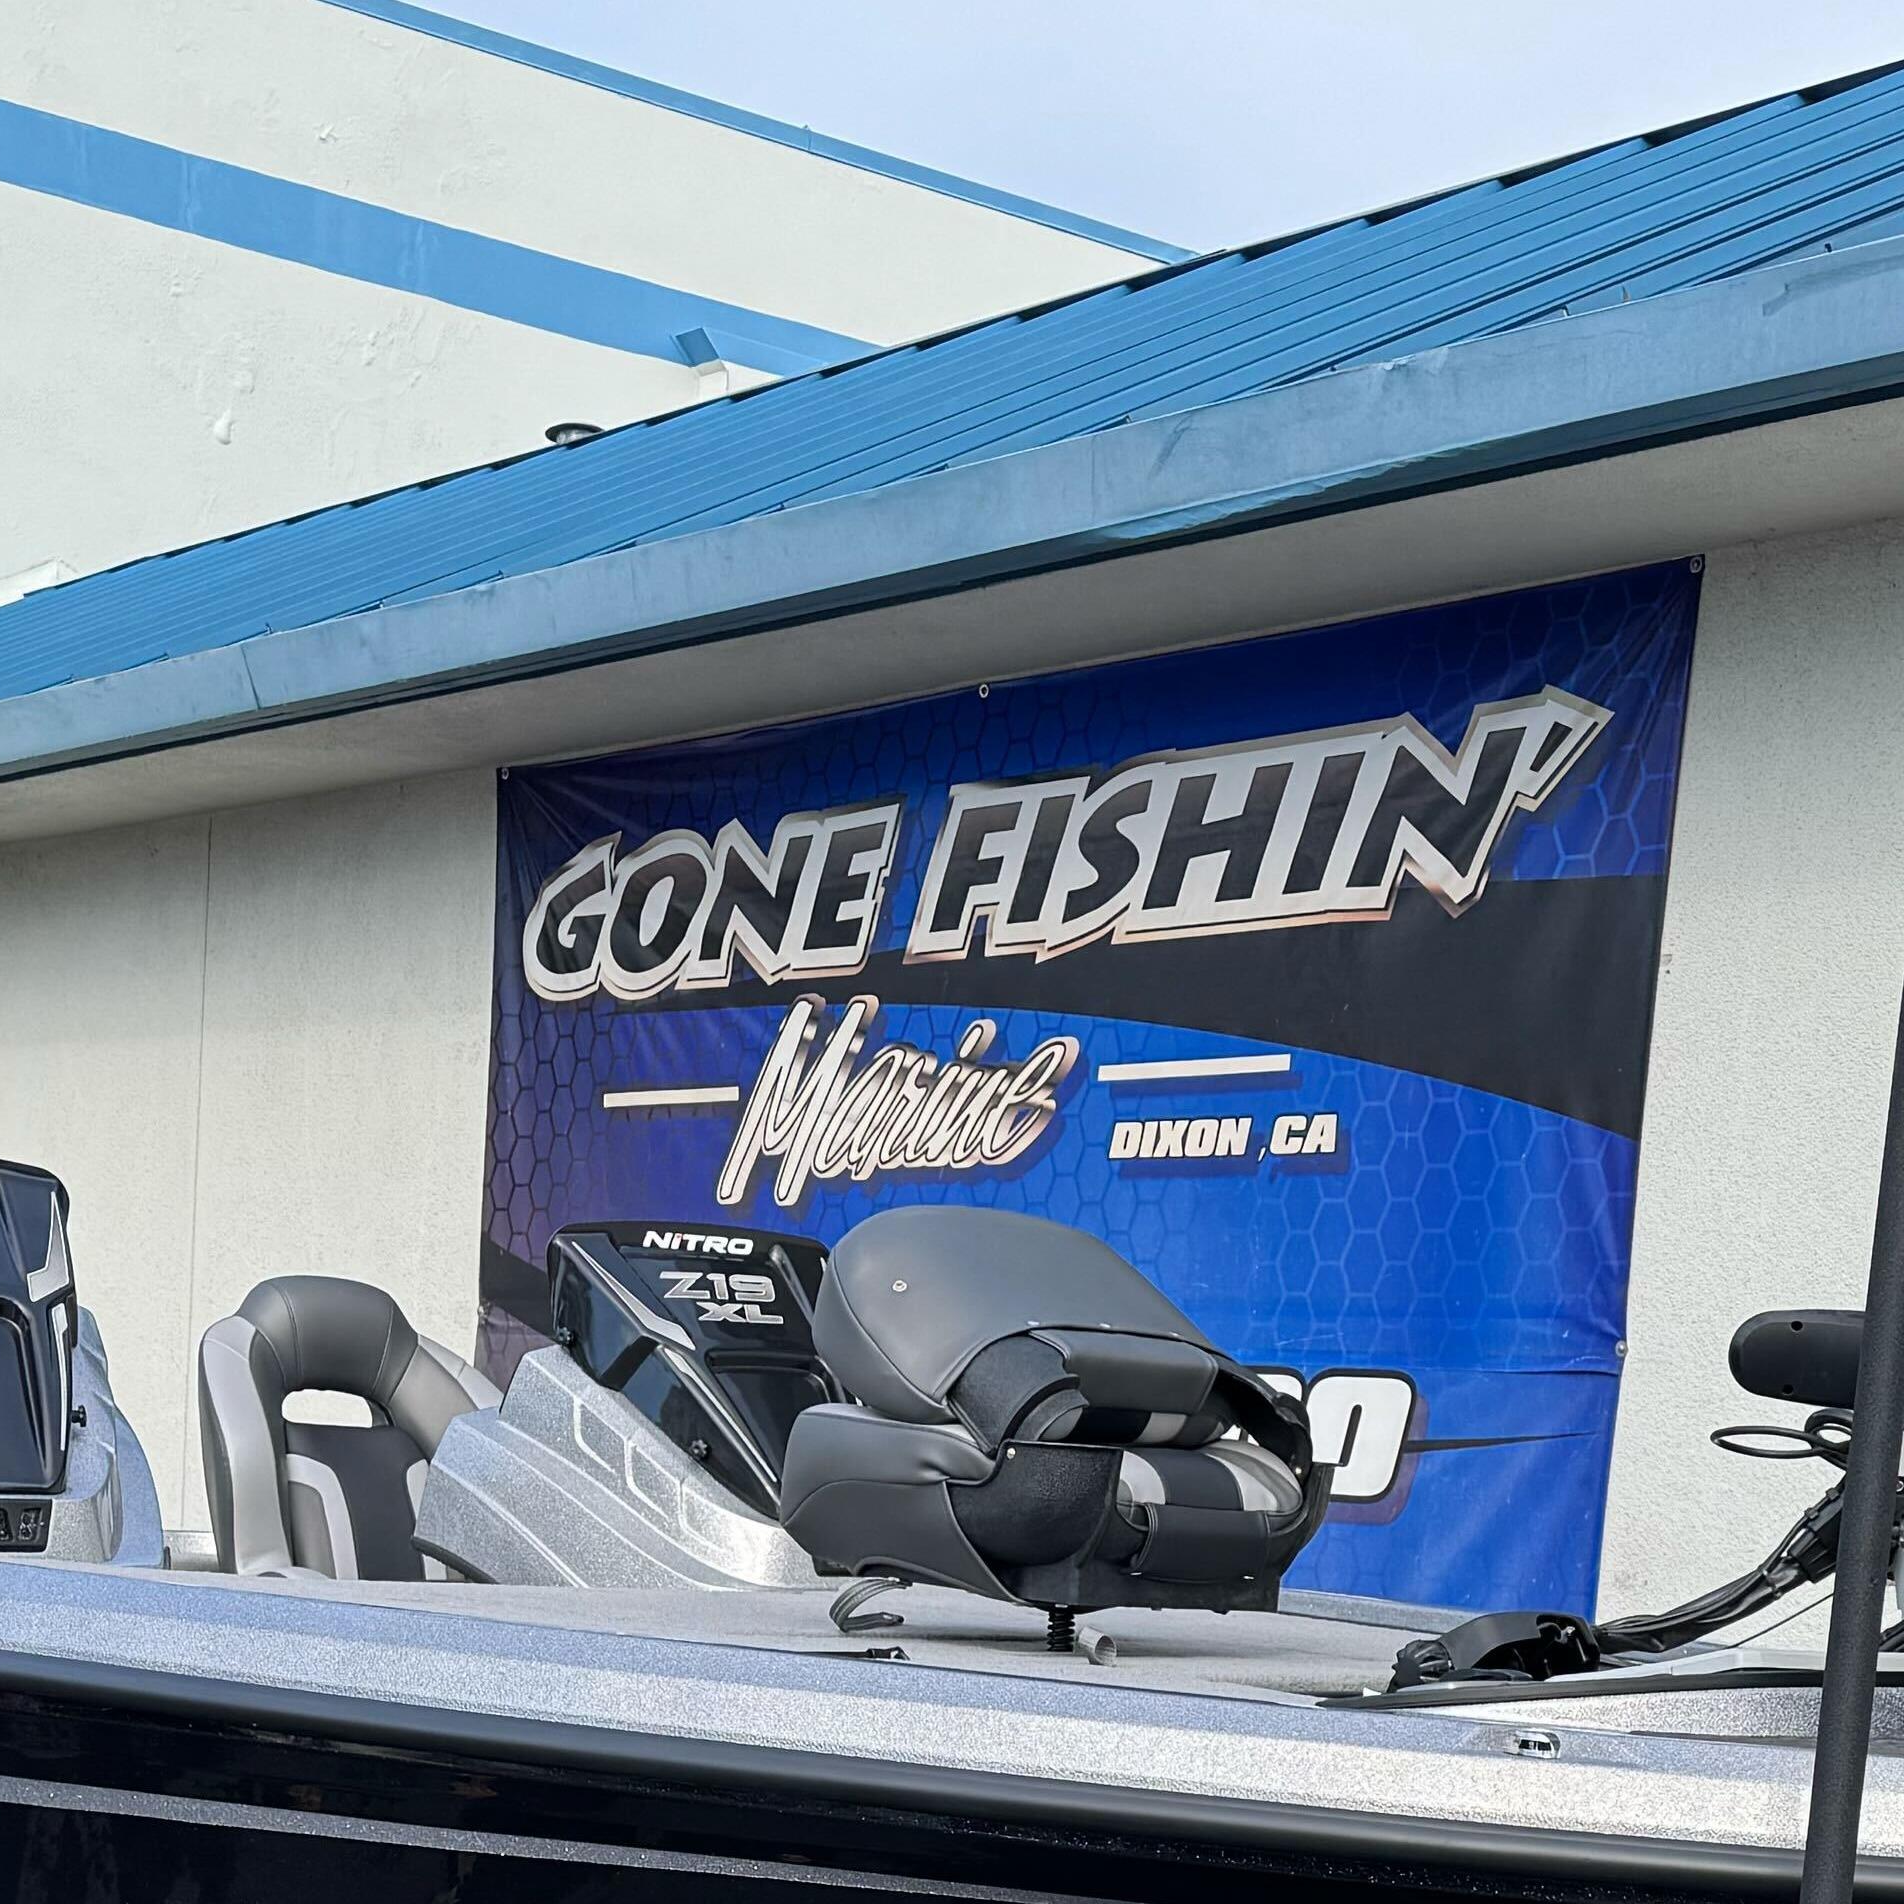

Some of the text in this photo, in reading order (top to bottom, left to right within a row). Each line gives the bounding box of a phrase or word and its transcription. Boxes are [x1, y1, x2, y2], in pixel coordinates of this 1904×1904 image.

[524, 803, 902, 1000] GONE
[717, 996, 1079, 1205] Marine
[1108, 1117, 1253, 1159] DIXON
[642, 1230, 754, 1256] NITRO
[659, 1271, 776, 1302] Z19
[696, 1301, 784, 1325] XL
